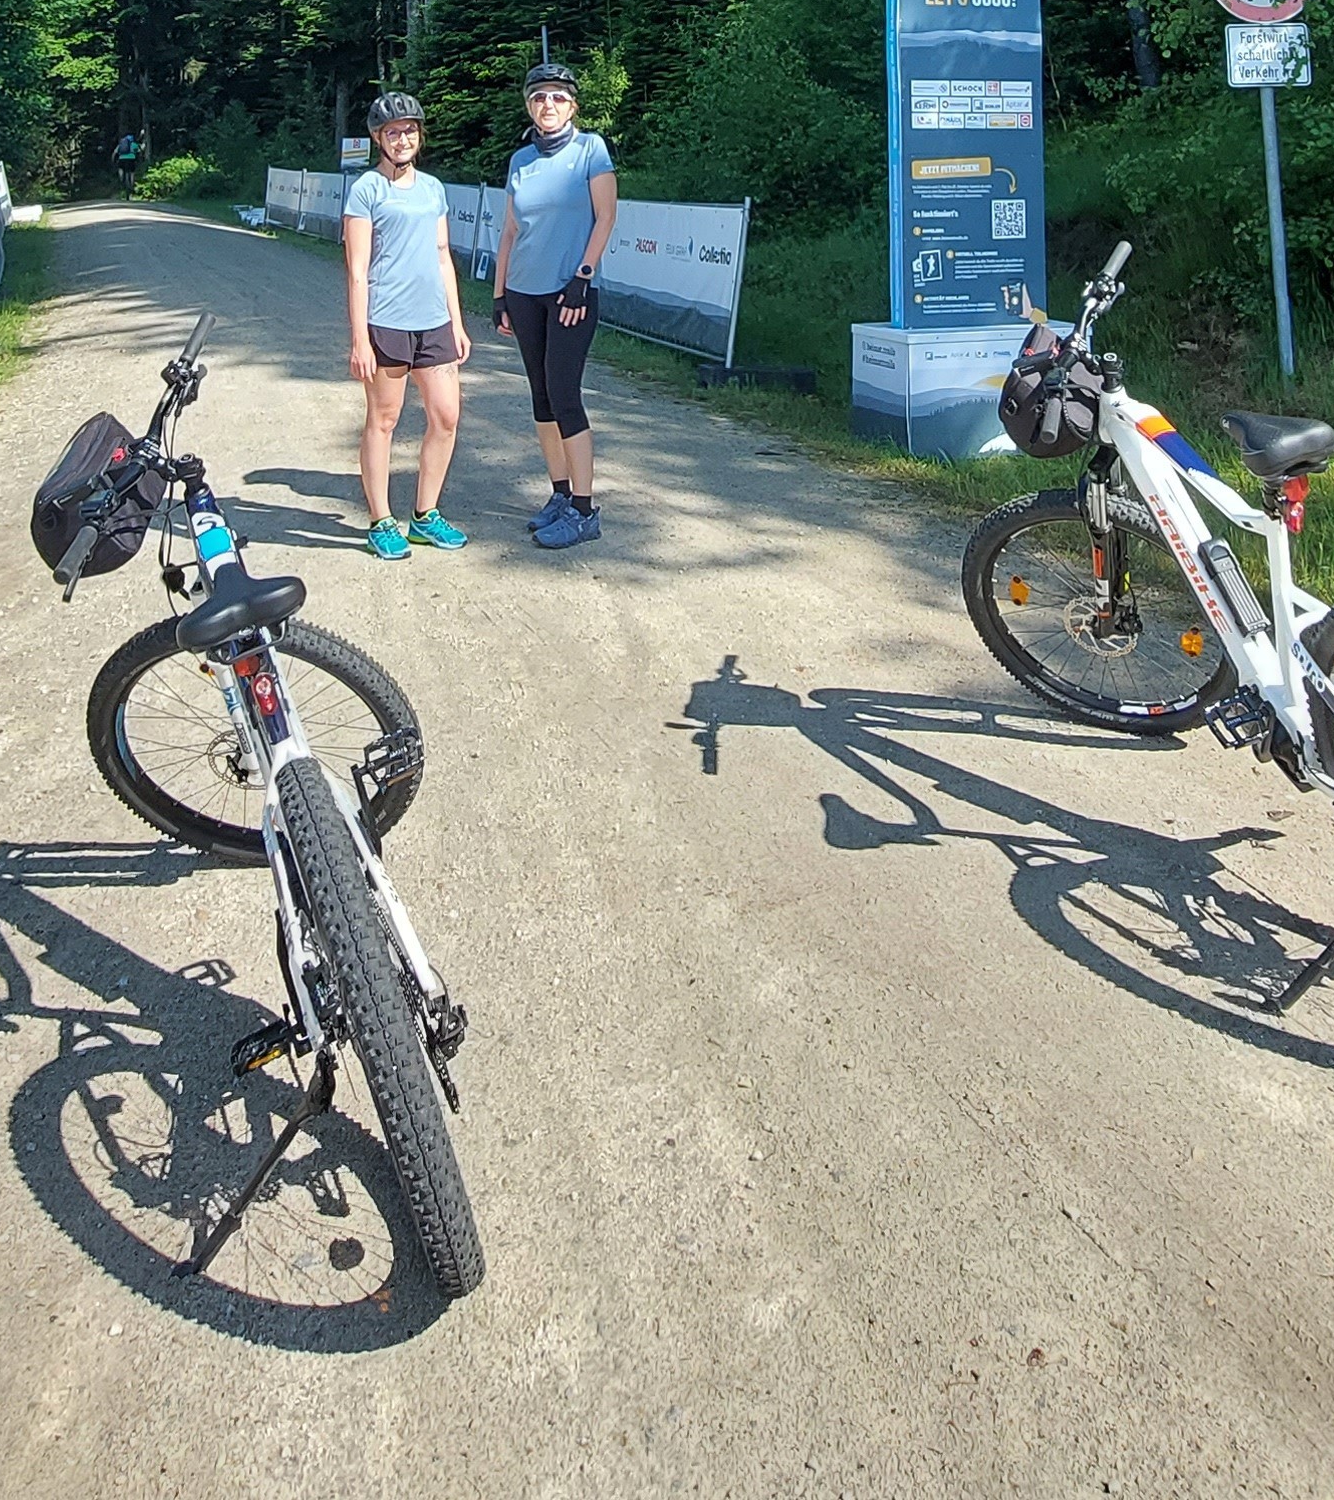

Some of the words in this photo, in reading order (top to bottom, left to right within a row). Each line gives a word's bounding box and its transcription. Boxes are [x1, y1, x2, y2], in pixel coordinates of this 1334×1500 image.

[1240, 31, 1294, 44] Forstwirt-
[1237, 48, 1290, 61] schaftlich
[1239, 65, 1279, 78] Verkehr
[1148, 493, 1233, 635] HAIBIKE
